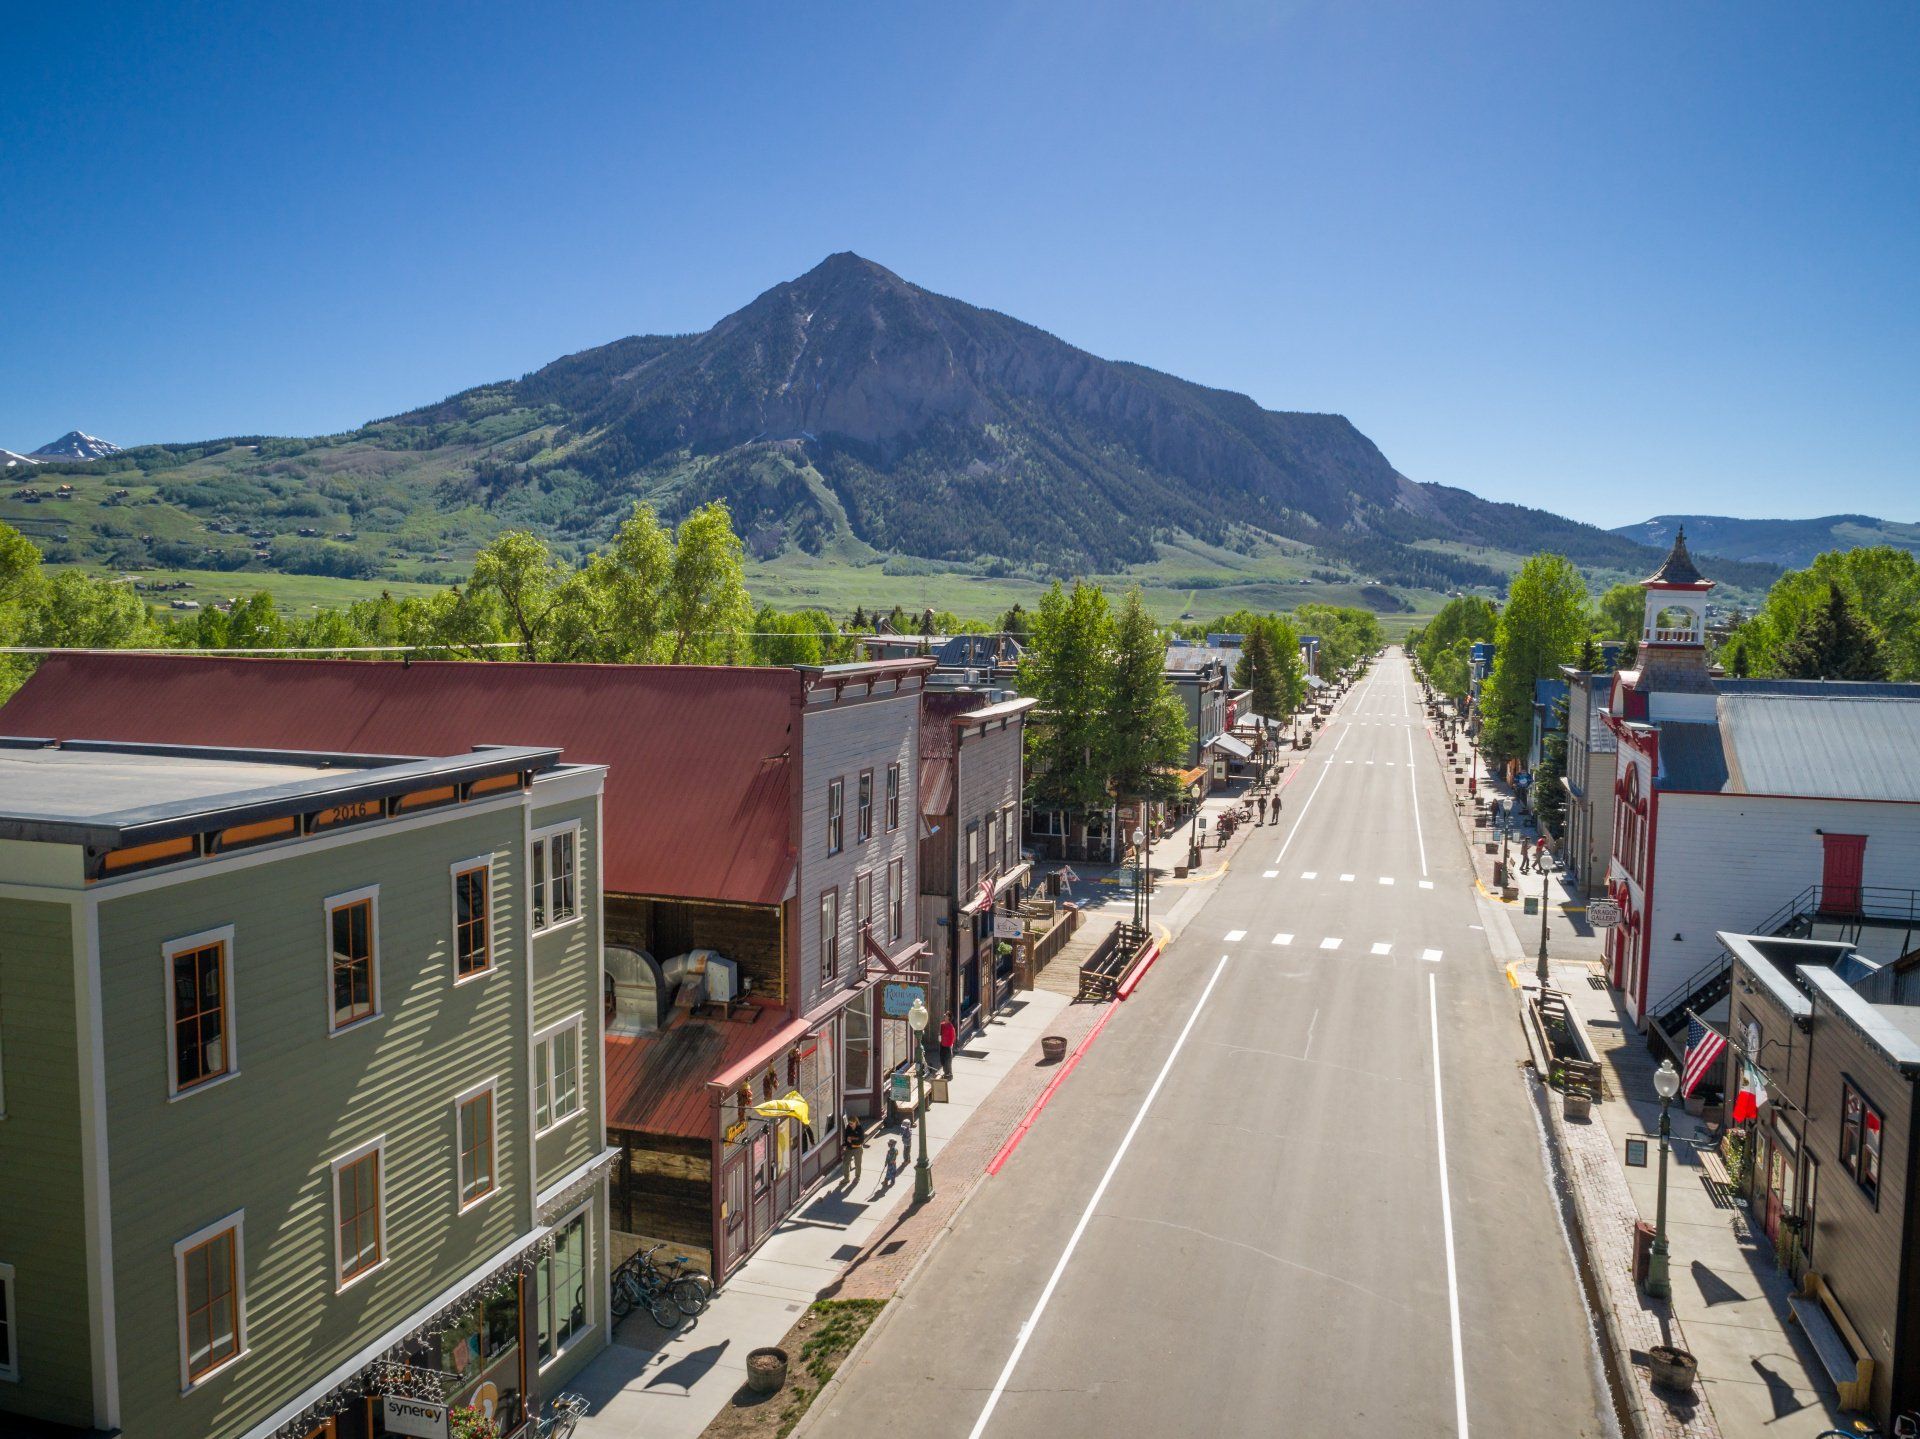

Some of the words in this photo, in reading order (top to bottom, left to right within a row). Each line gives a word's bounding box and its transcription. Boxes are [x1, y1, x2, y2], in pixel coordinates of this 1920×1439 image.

[333, 803, 366, 822] 2016
[1590, 908, 1617, 916] PARAGON
[389, 1402, 442, 1423] synergy
